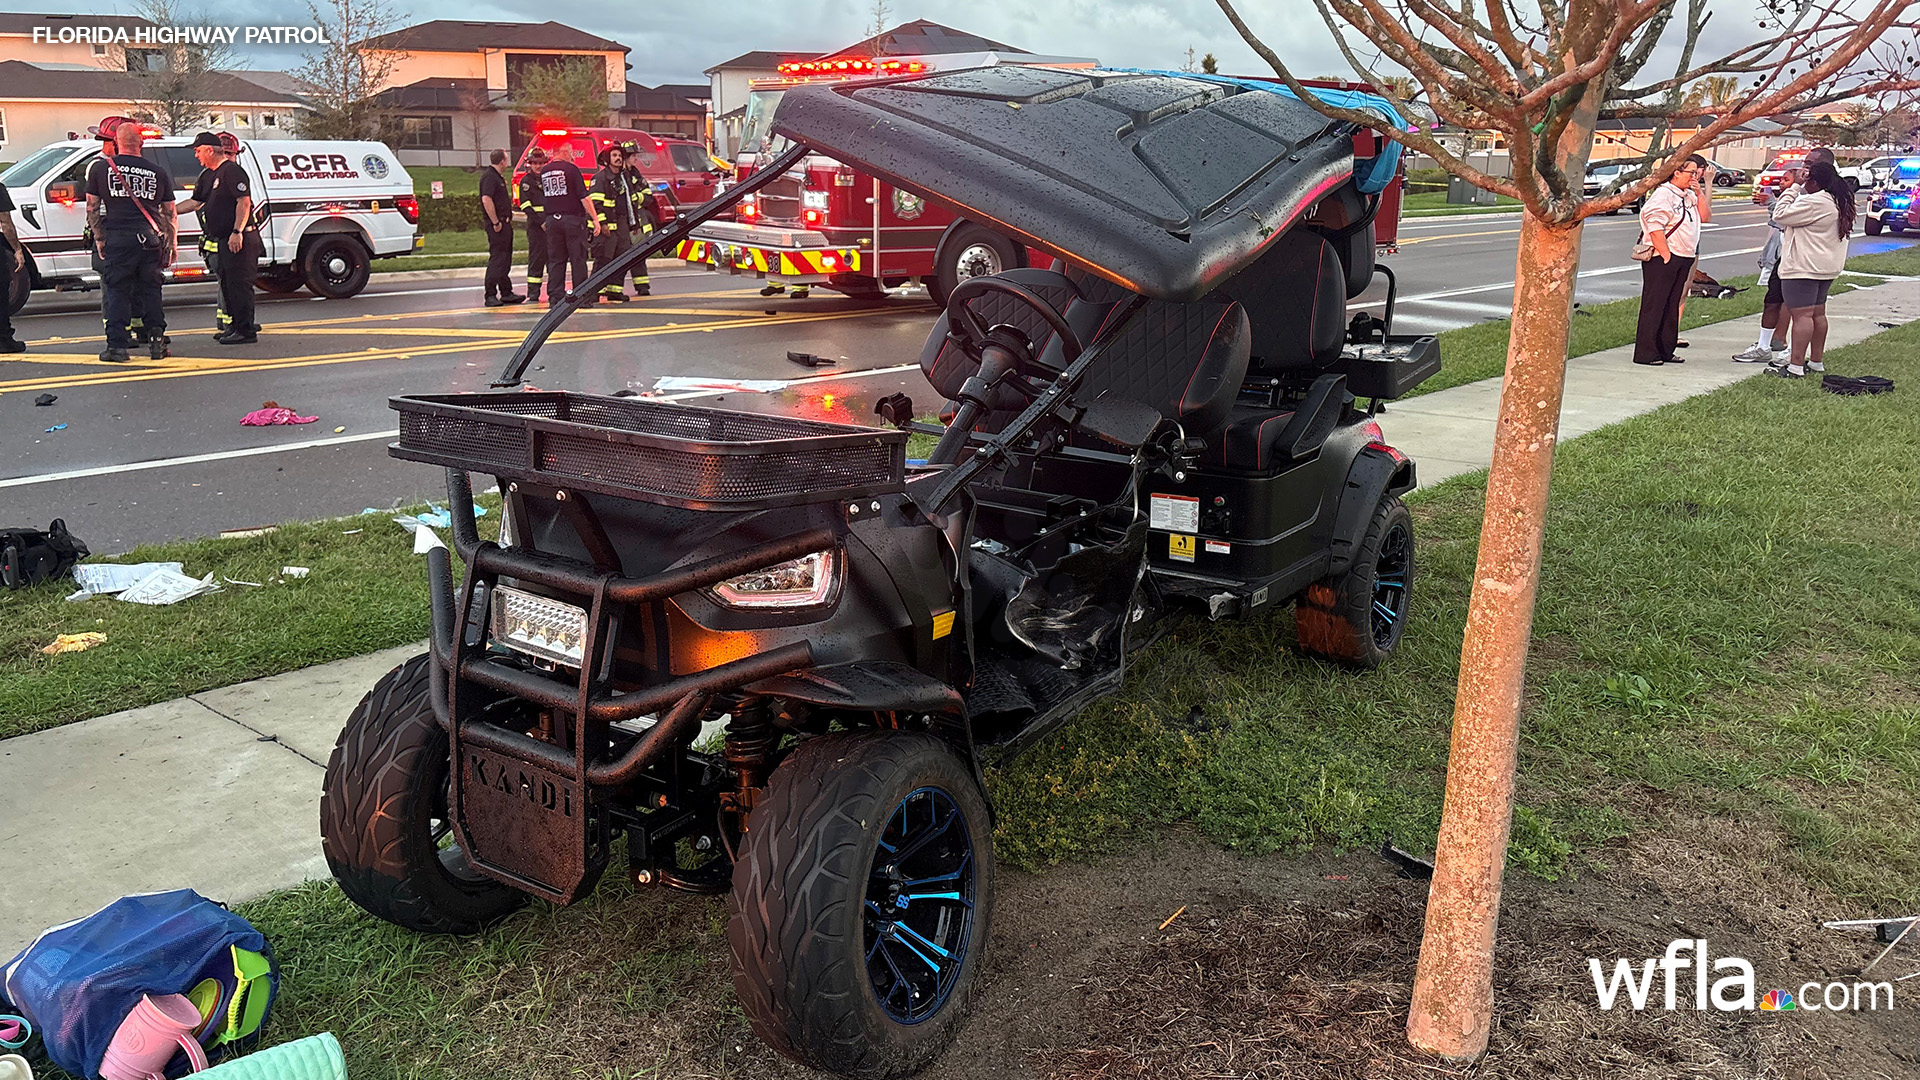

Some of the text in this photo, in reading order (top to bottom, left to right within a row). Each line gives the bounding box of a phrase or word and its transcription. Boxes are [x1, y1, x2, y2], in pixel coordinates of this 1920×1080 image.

[270, 154, 350, 172] PCFR
[268, 171, 360, 180] EMS SUPERVISOR
[542, 176, 567, 191] FIRE
[768, 255, 780, 273] 38
[472, 755, 572, 817] KANDI
